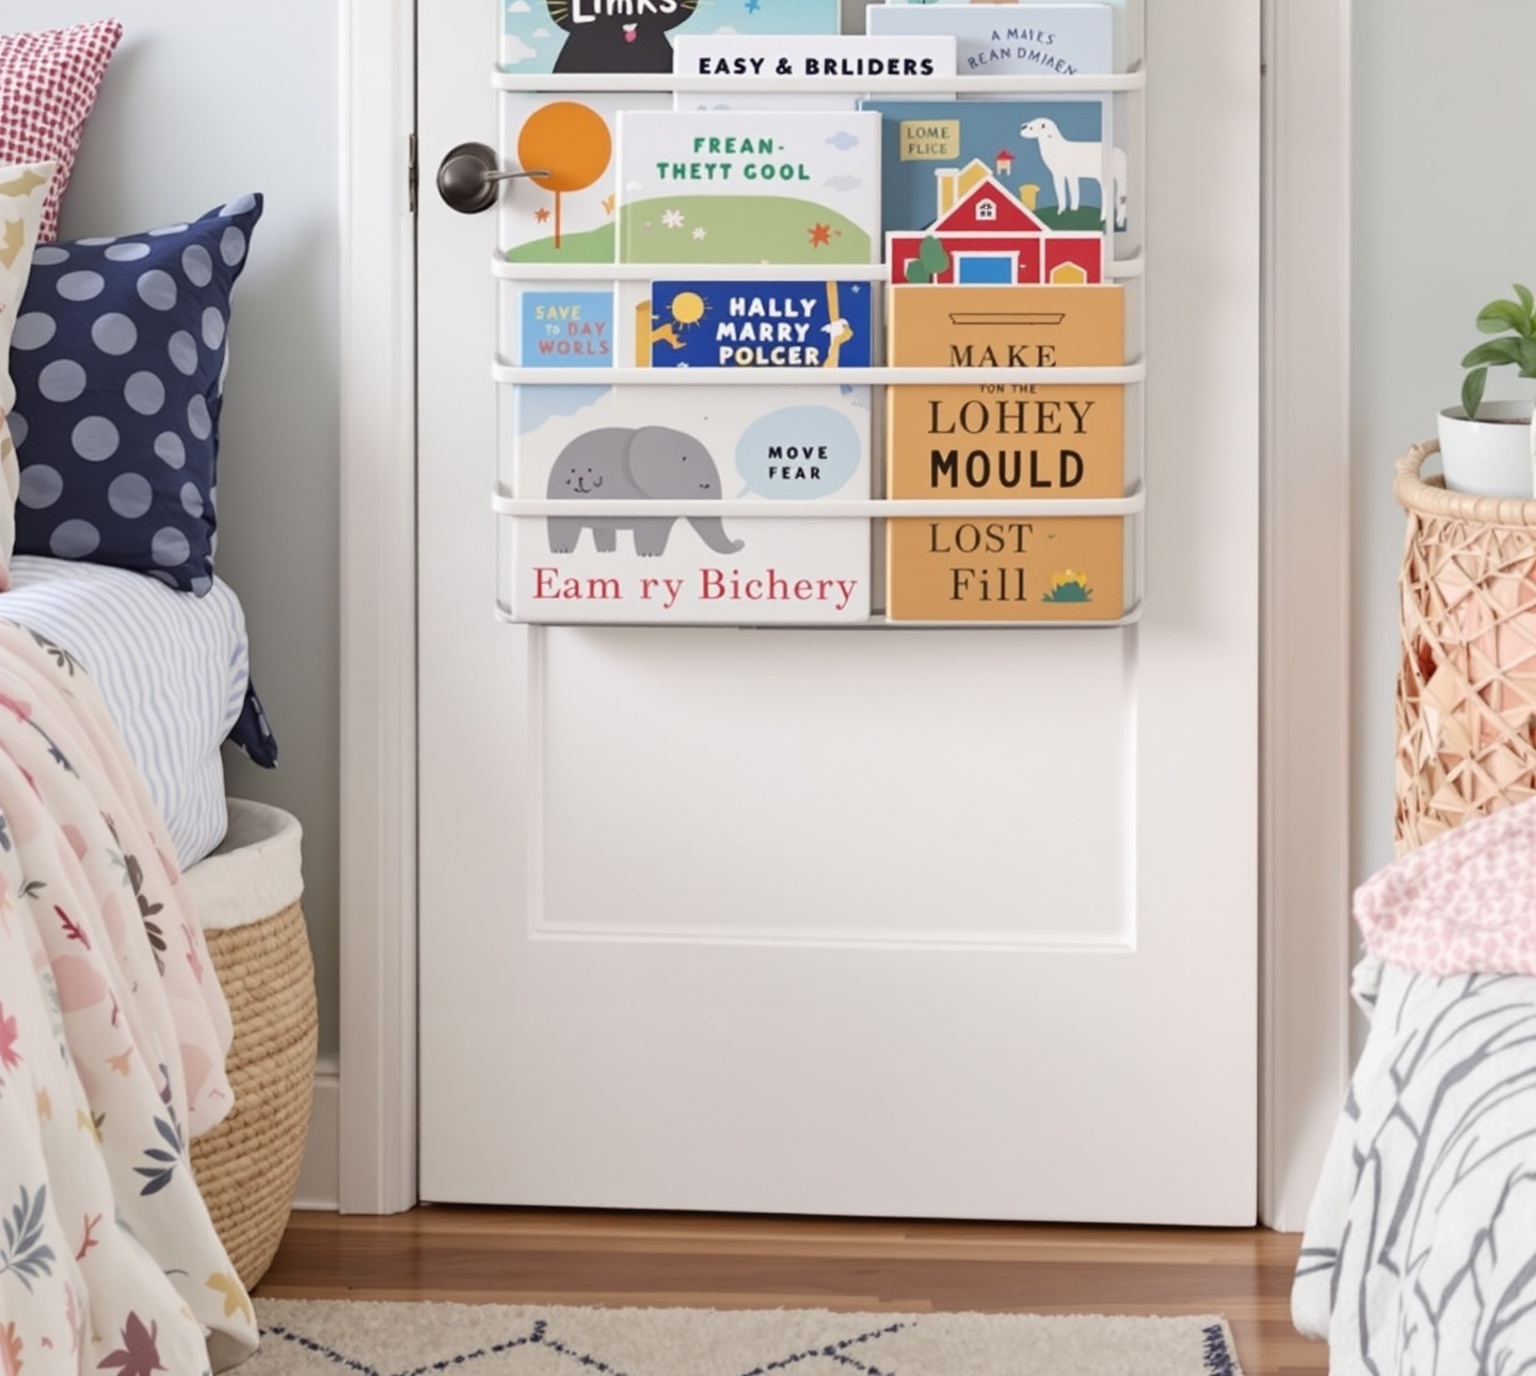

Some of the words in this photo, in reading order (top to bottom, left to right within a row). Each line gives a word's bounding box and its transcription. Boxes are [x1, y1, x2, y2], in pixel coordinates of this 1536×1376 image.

[699, 58, 764, 74] EASY
[776, 58, 792, 75] &
[806, 58, 933, 76] BRLIDERS
[906, 127, 949, 140] LOME
[694, 137, 784, 154] FREAN-
[906, 143, 946, 155] FLICE
[536, 306, 580, 321] SAVE
[730, 297, 816, 317] HALLY
[568, 321, 605, 336] DAY
[716, 322, 809, 342] MARRY
[720, 346, 819, 365] POLCER
[951, 345, 1056, 366] MAKE
[1011, 384, 1036, 394] THE
[928, 400, 1095, 434] LOHEY
[768, 446, 827, 459] MOVE
[769, 467, 820, 479] FEAR
[931, 450, 1083, 488] MOULD
[930, 524, 1032, 552] LOST
[533, 568, 622, 599] Eam
[640, 579, 683, 609] ry
[700, 569, 857, 610] Bichery
[951, 568, 1026, 601] Fill
